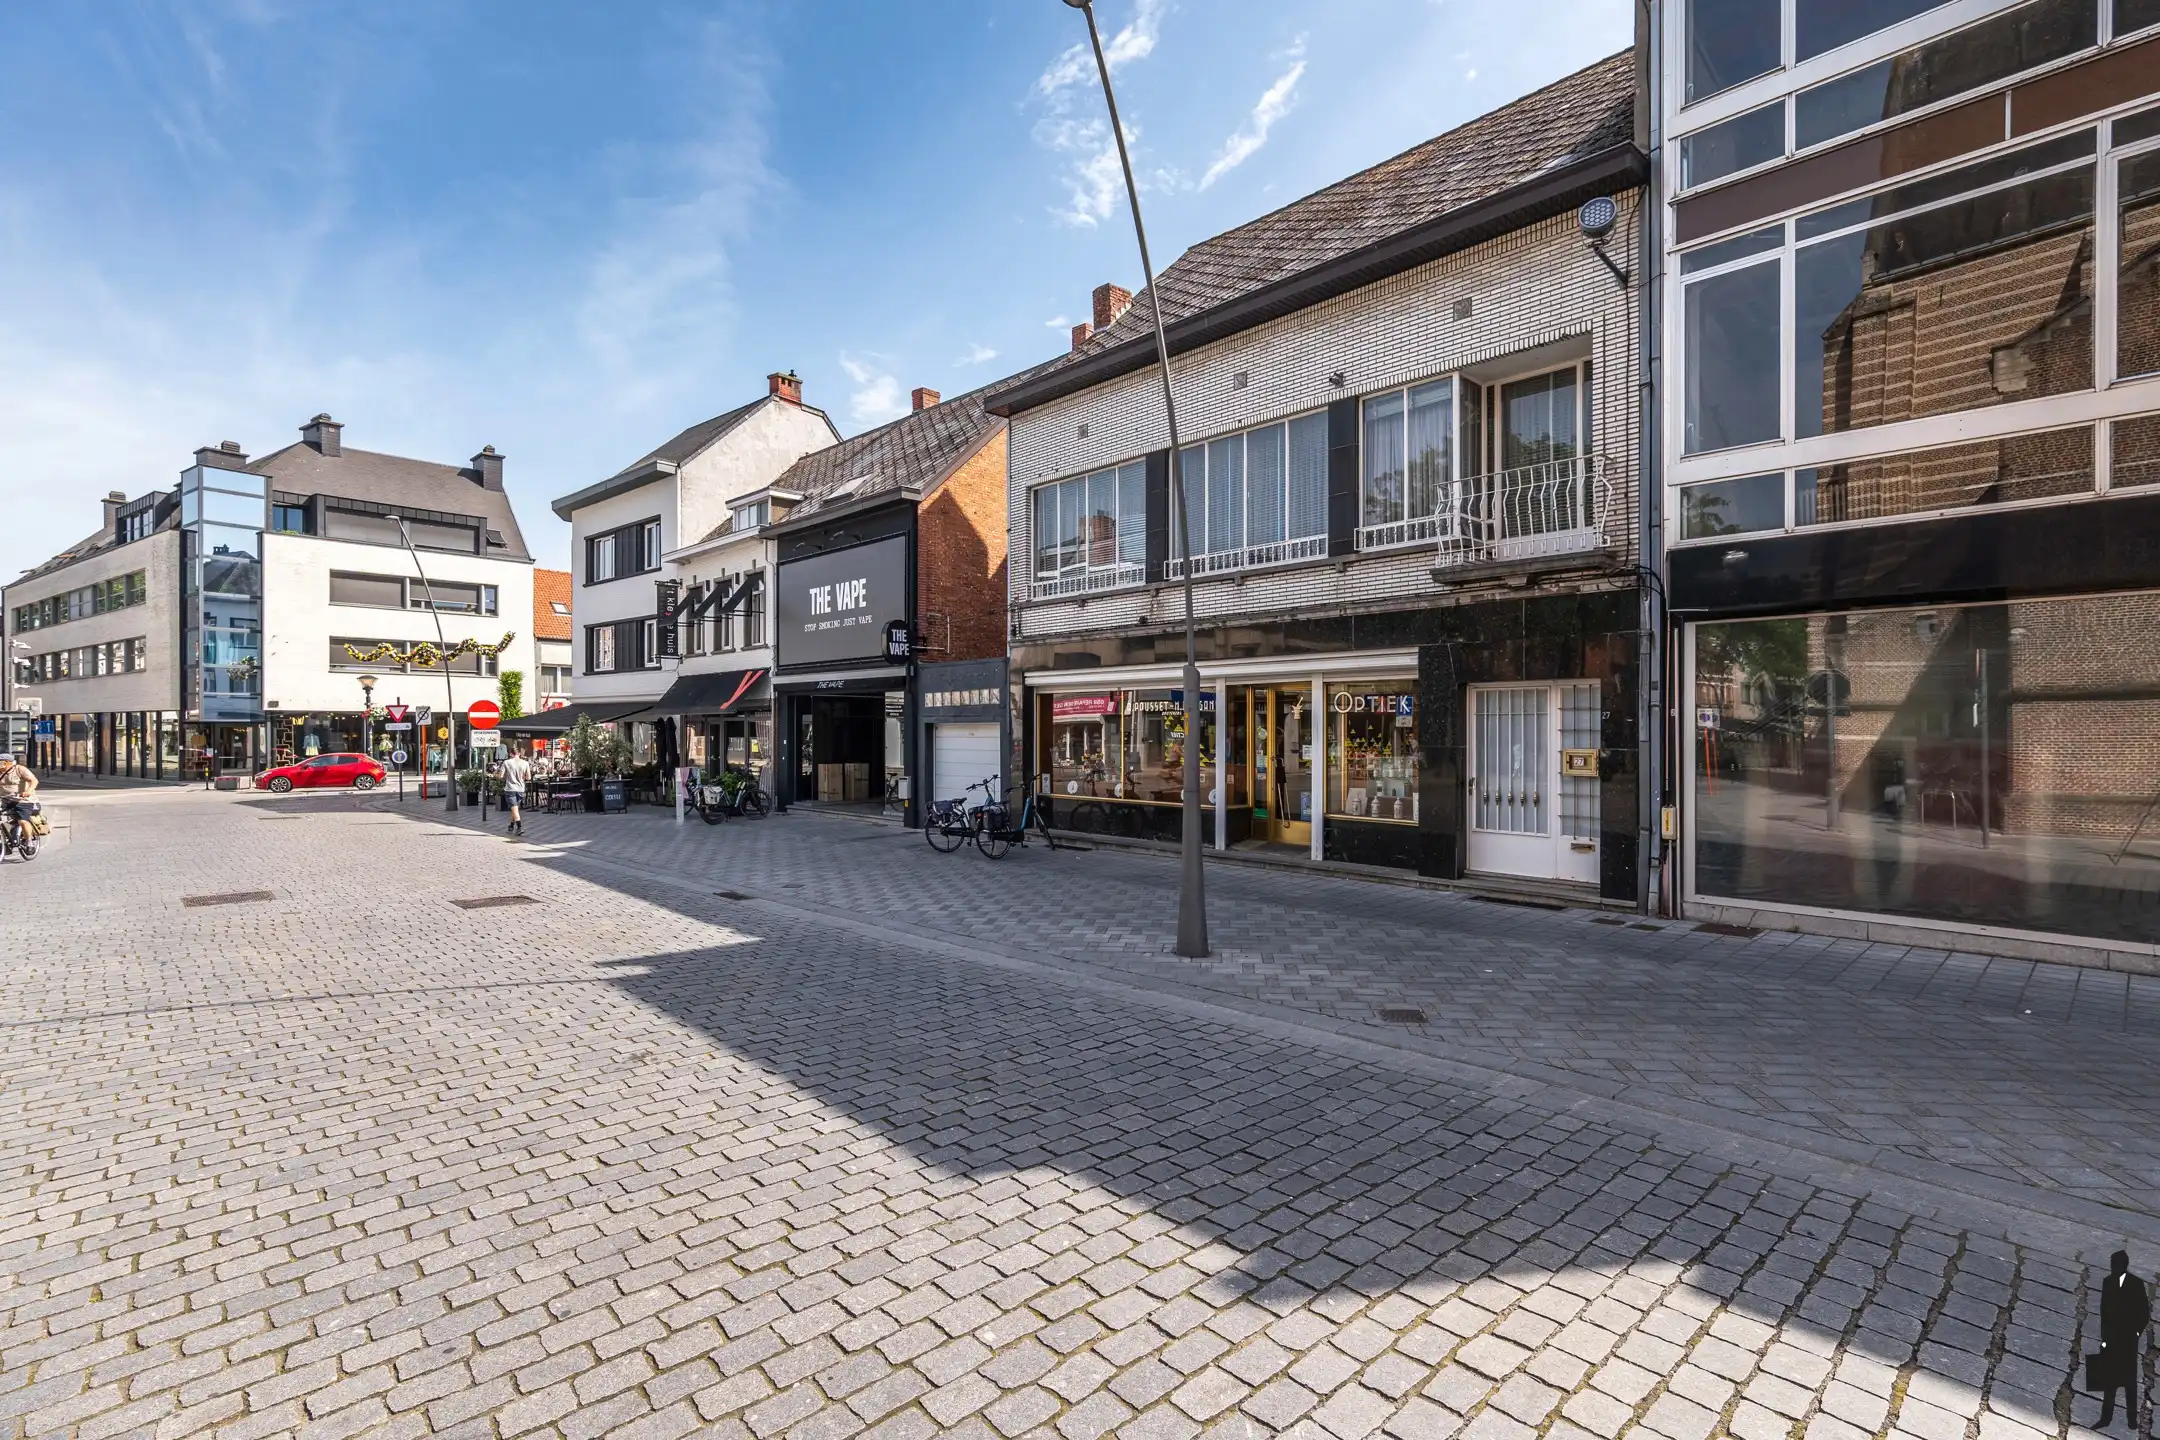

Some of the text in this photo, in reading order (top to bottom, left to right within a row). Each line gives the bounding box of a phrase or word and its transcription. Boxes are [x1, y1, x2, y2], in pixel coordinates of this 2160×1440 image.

[809, 578, 867, 615] THE VAPE
[804, 614, 873, 632] STOP SMOKING JUST VAPE
[666, 633, 676, 653] huis
[891, 629, 907, 642] THE
[889, 642, 910, 656] VAPE
[1334, 691, 1411, 713] OPTIEK
[1601, 711, 1611, 719] 27
